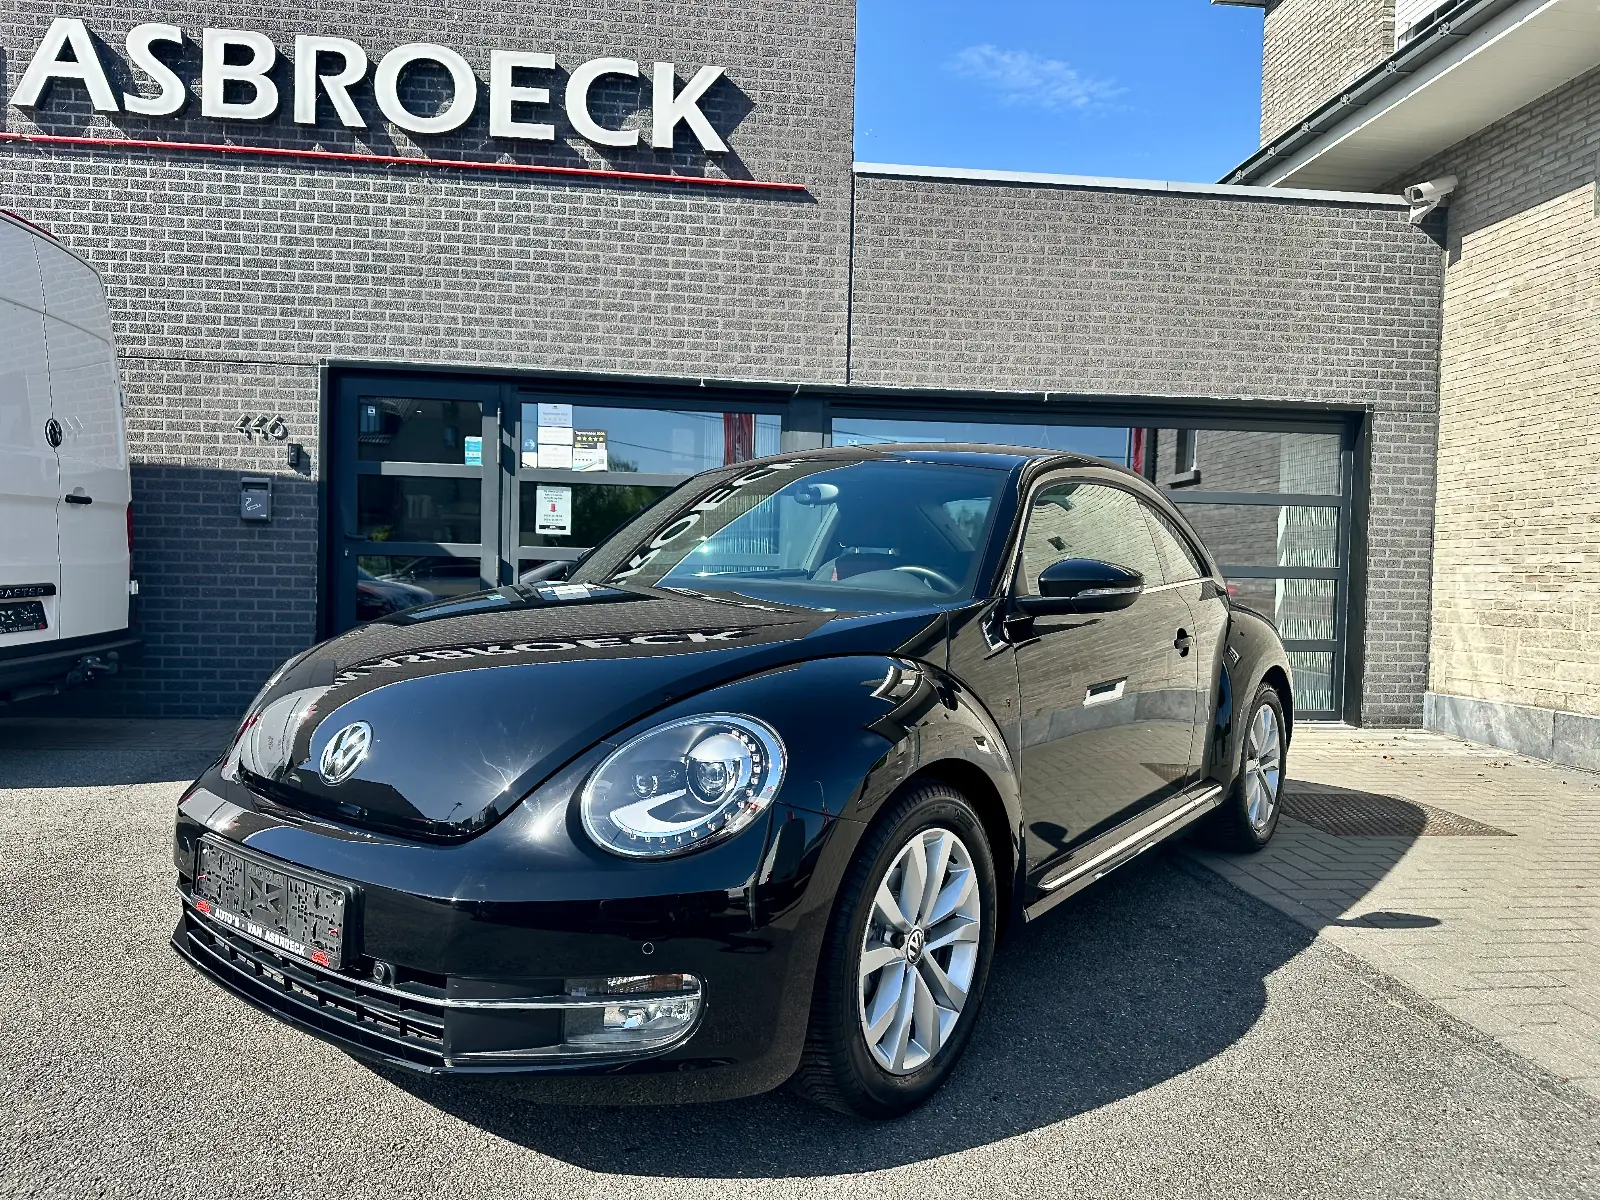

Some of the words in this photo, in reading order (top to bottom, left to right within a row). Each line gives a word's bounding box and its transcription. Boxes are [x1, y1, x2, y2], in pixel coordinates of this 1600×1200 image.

[10, 16, 729, 154] ASBROECK
[247, 922, 263, 939] VAN
[264, 929, 306, 956] ASBROECK
